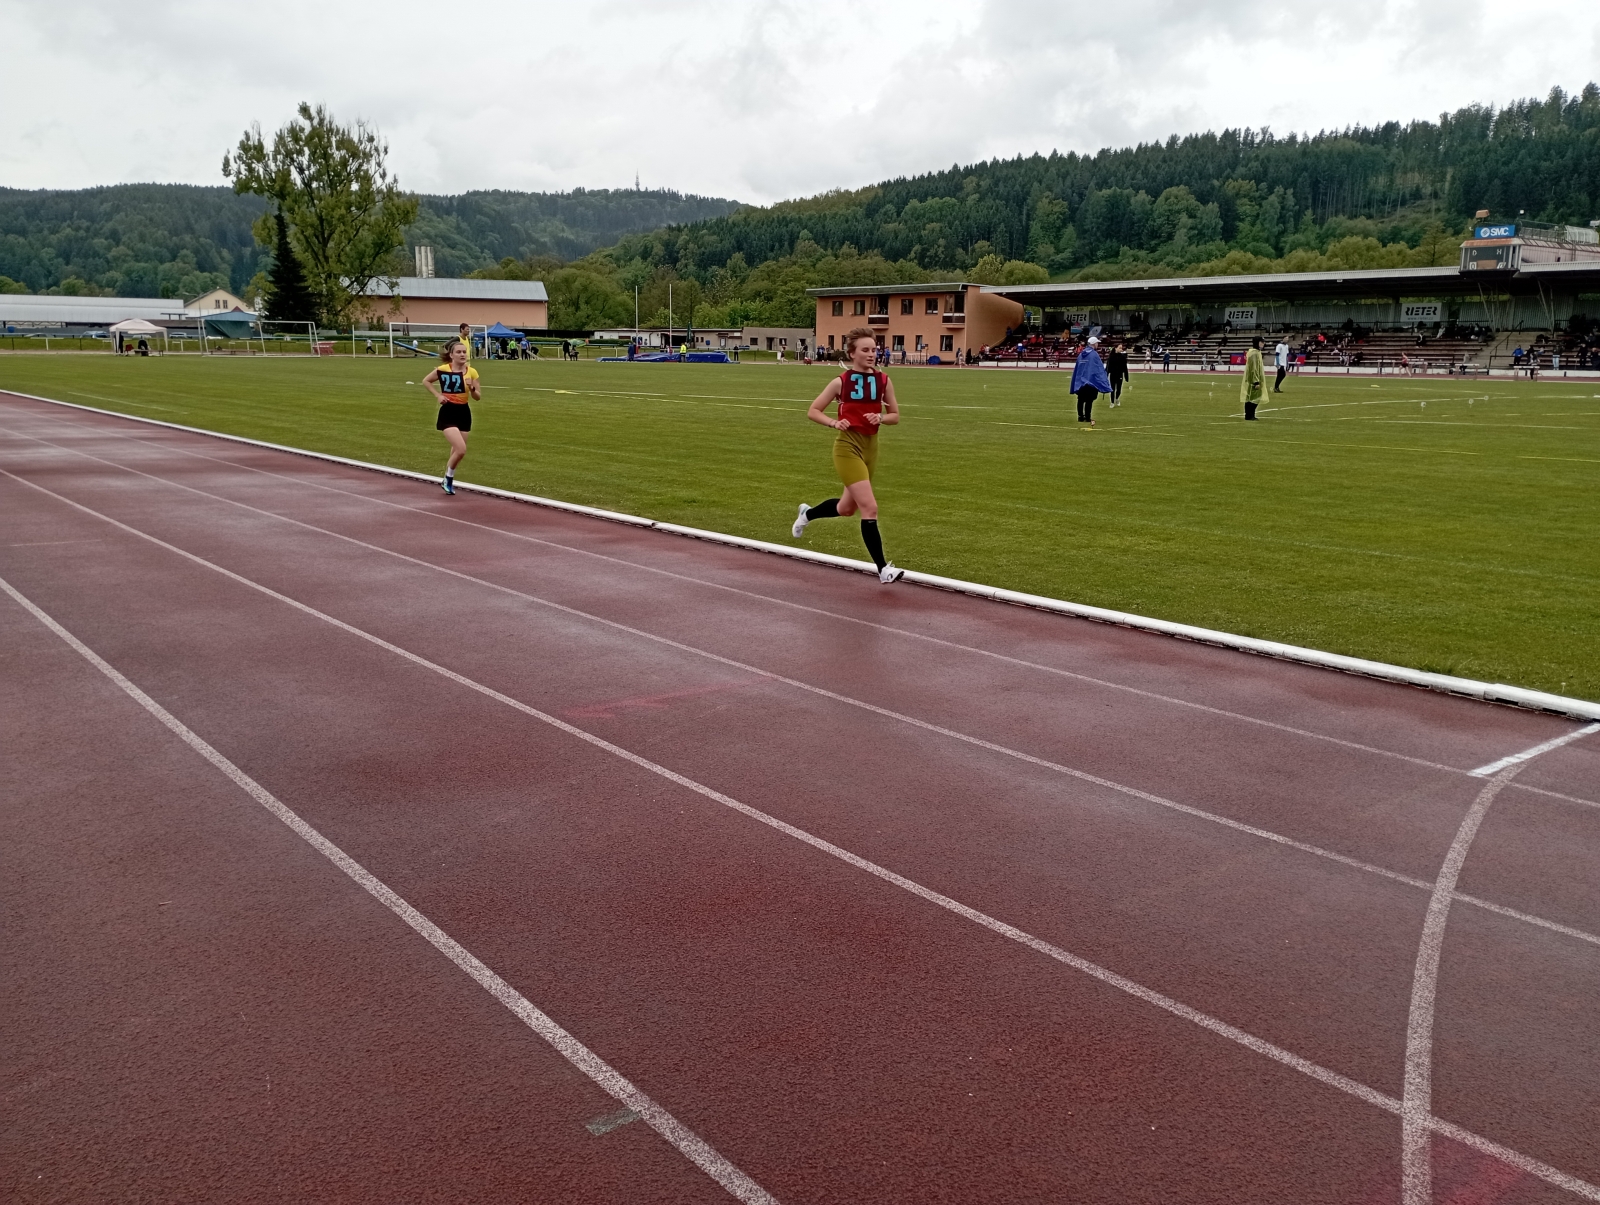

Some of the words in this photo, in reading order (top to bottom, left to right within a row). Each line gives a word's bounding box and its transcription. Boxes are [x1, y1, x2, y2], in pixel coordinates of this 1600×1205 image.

[1490, 227, 1509, 236] SMC
[1228, 311, 1254, 319] RIETER
[1405, 306, 1438, 316] RIETER
[440, 373, 462, 393] 22
[850, 373, 877, 400] 31
